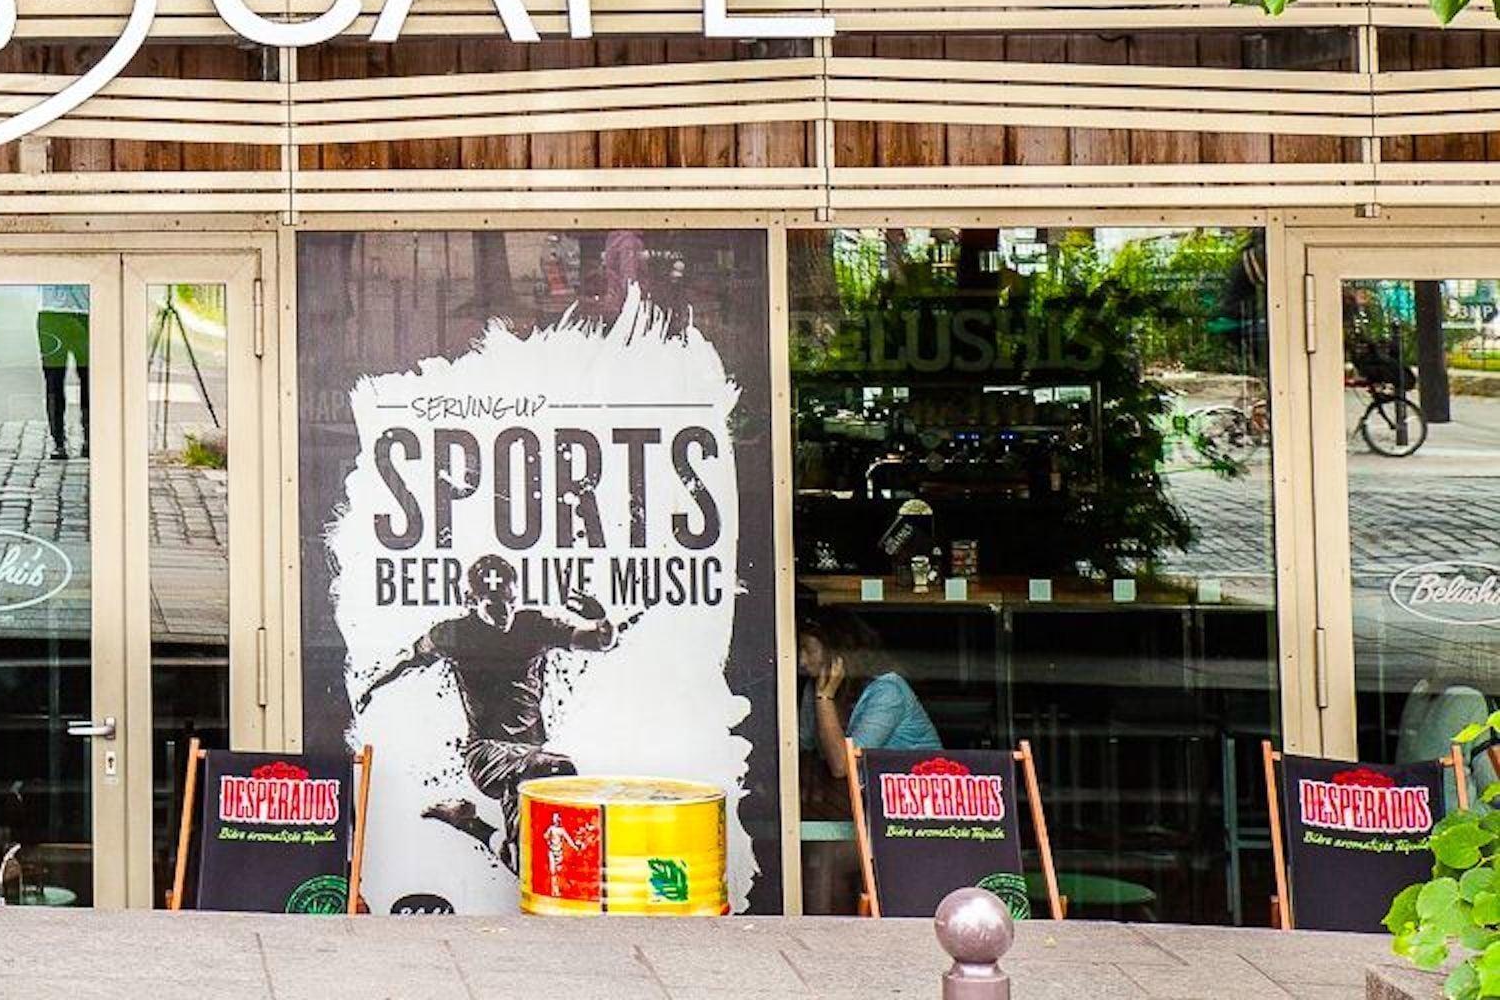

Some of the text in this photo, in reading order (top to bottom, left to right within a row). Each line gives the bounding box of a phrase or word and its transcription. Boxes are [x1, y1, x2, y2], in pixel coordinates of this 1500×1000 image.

[373, 426, 722, 551] SPORTS
[375, 557, 463, 607] BEER
[522, 557, 595, 606] LIVE
[611, 556, 723, 607] MUSIC
[222, 777, 339, 823] DESPERADOS
[881, 775, 1003, 819] DESPERADOS
[1301, 781, 1431, 832] DESPERADOS
